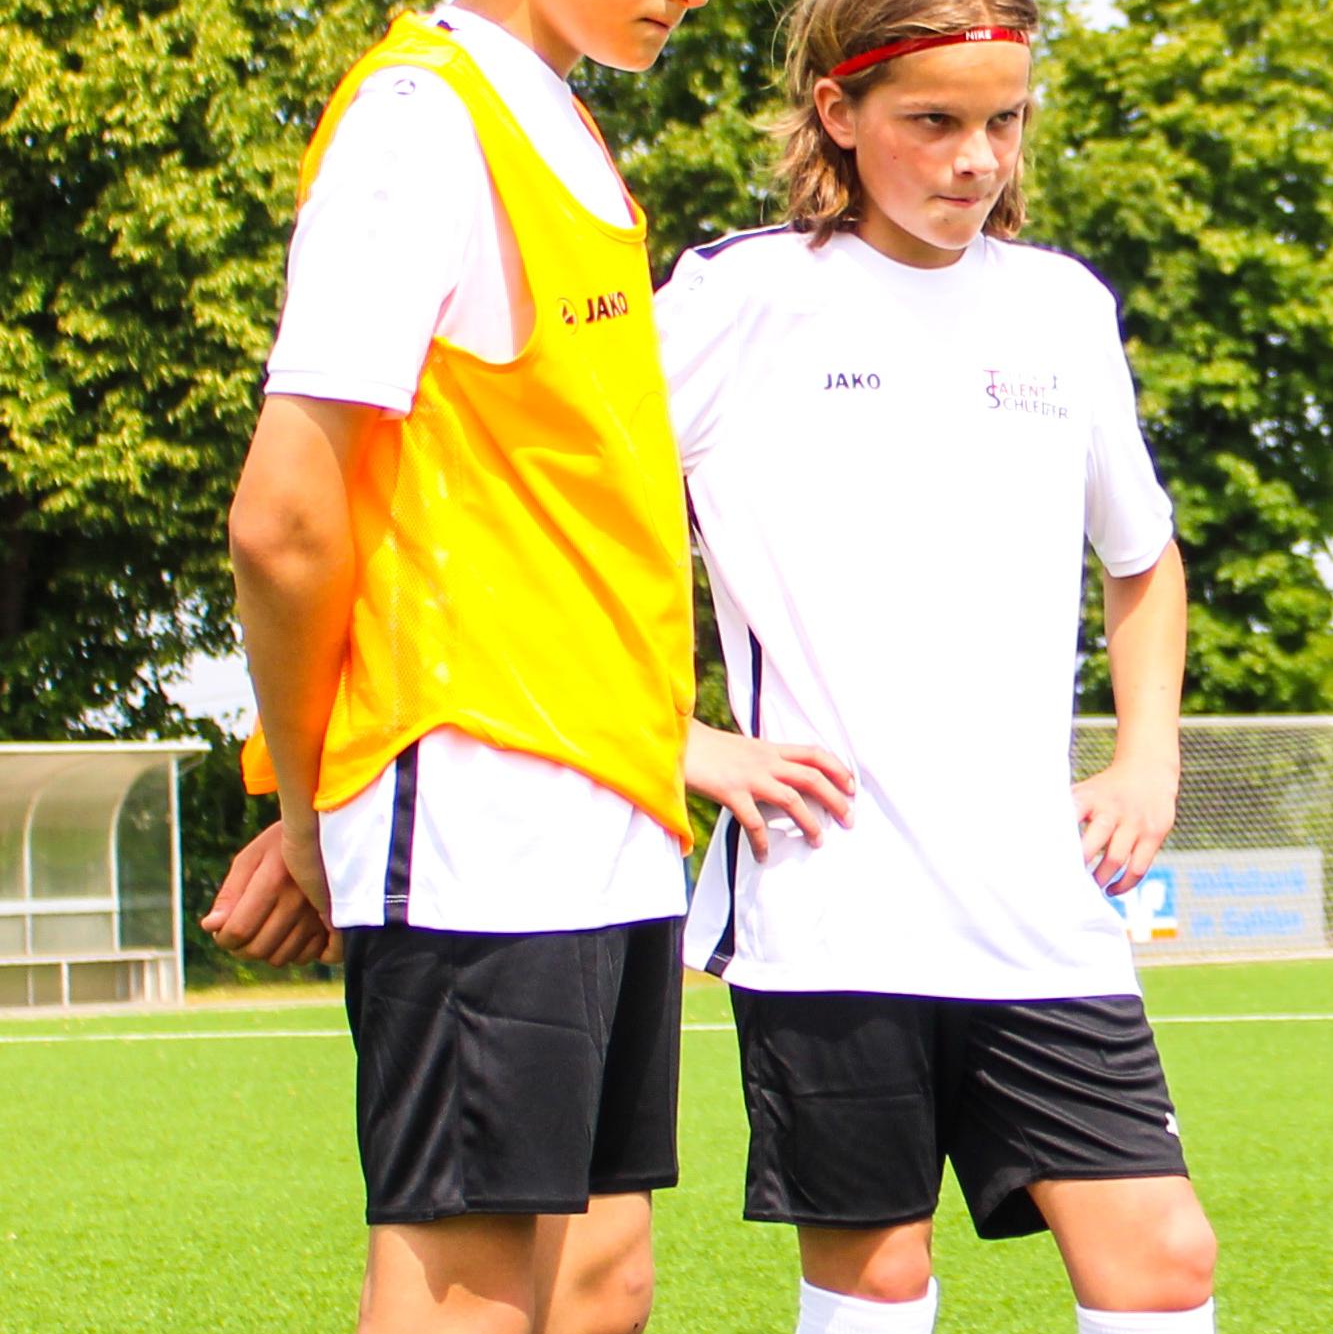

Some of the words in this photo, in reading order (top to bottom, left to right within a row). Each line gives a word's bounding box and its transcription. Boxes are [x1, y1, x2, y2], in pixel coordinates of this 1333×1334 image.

[965, 28, 992, 41] NIKE
[585, 291, 628, 323] JAKO
[823, 372, 881, 390] JAKO
